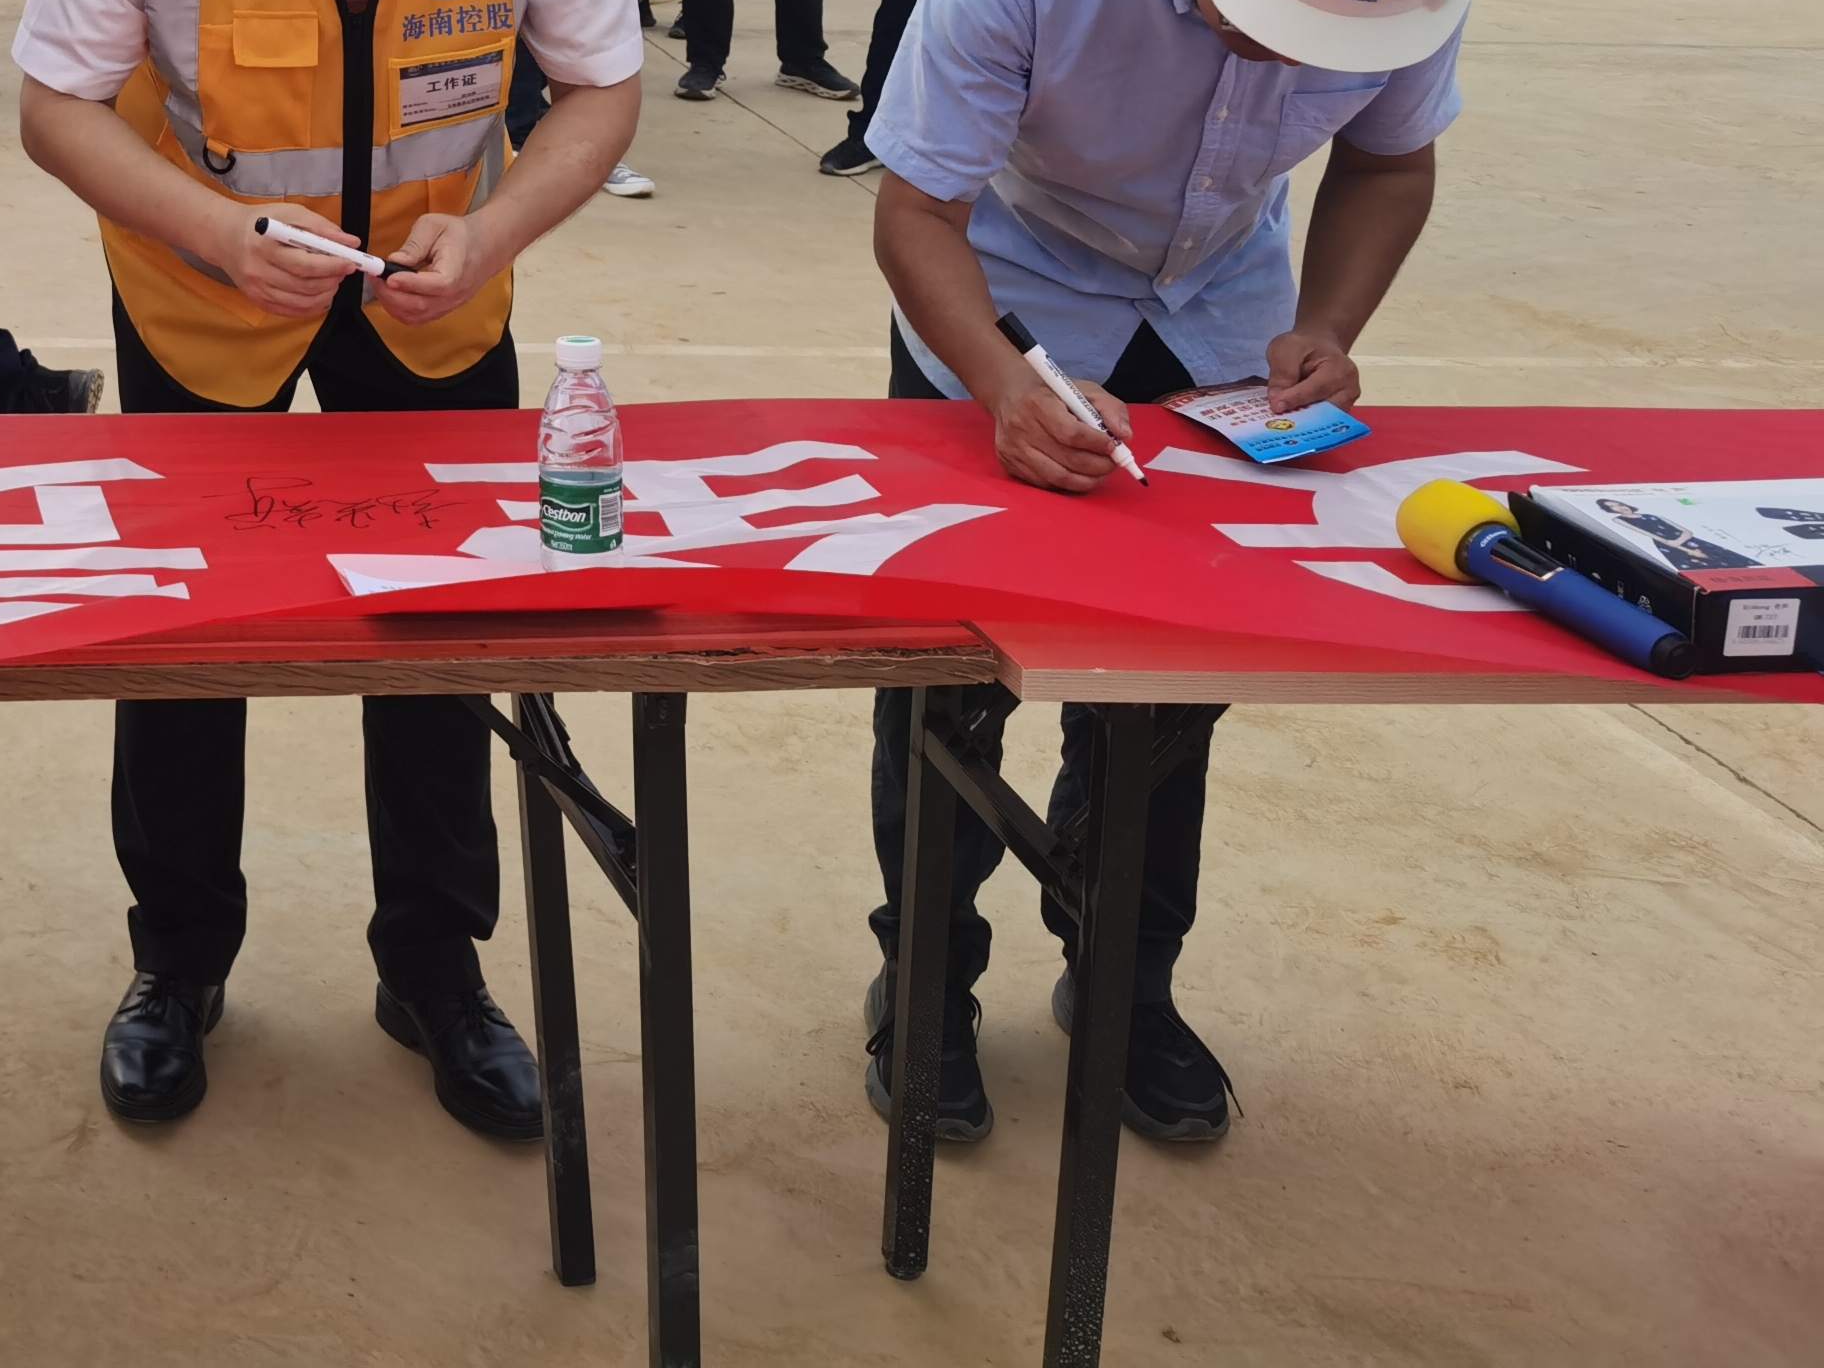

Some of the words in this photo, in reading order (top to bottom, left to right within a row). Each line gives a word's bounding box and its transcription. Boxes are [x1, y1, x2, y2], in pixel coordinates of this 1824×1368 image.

[402, 2, 514, 42] 海南控股
[426, 72, 478, 94] 工作证
